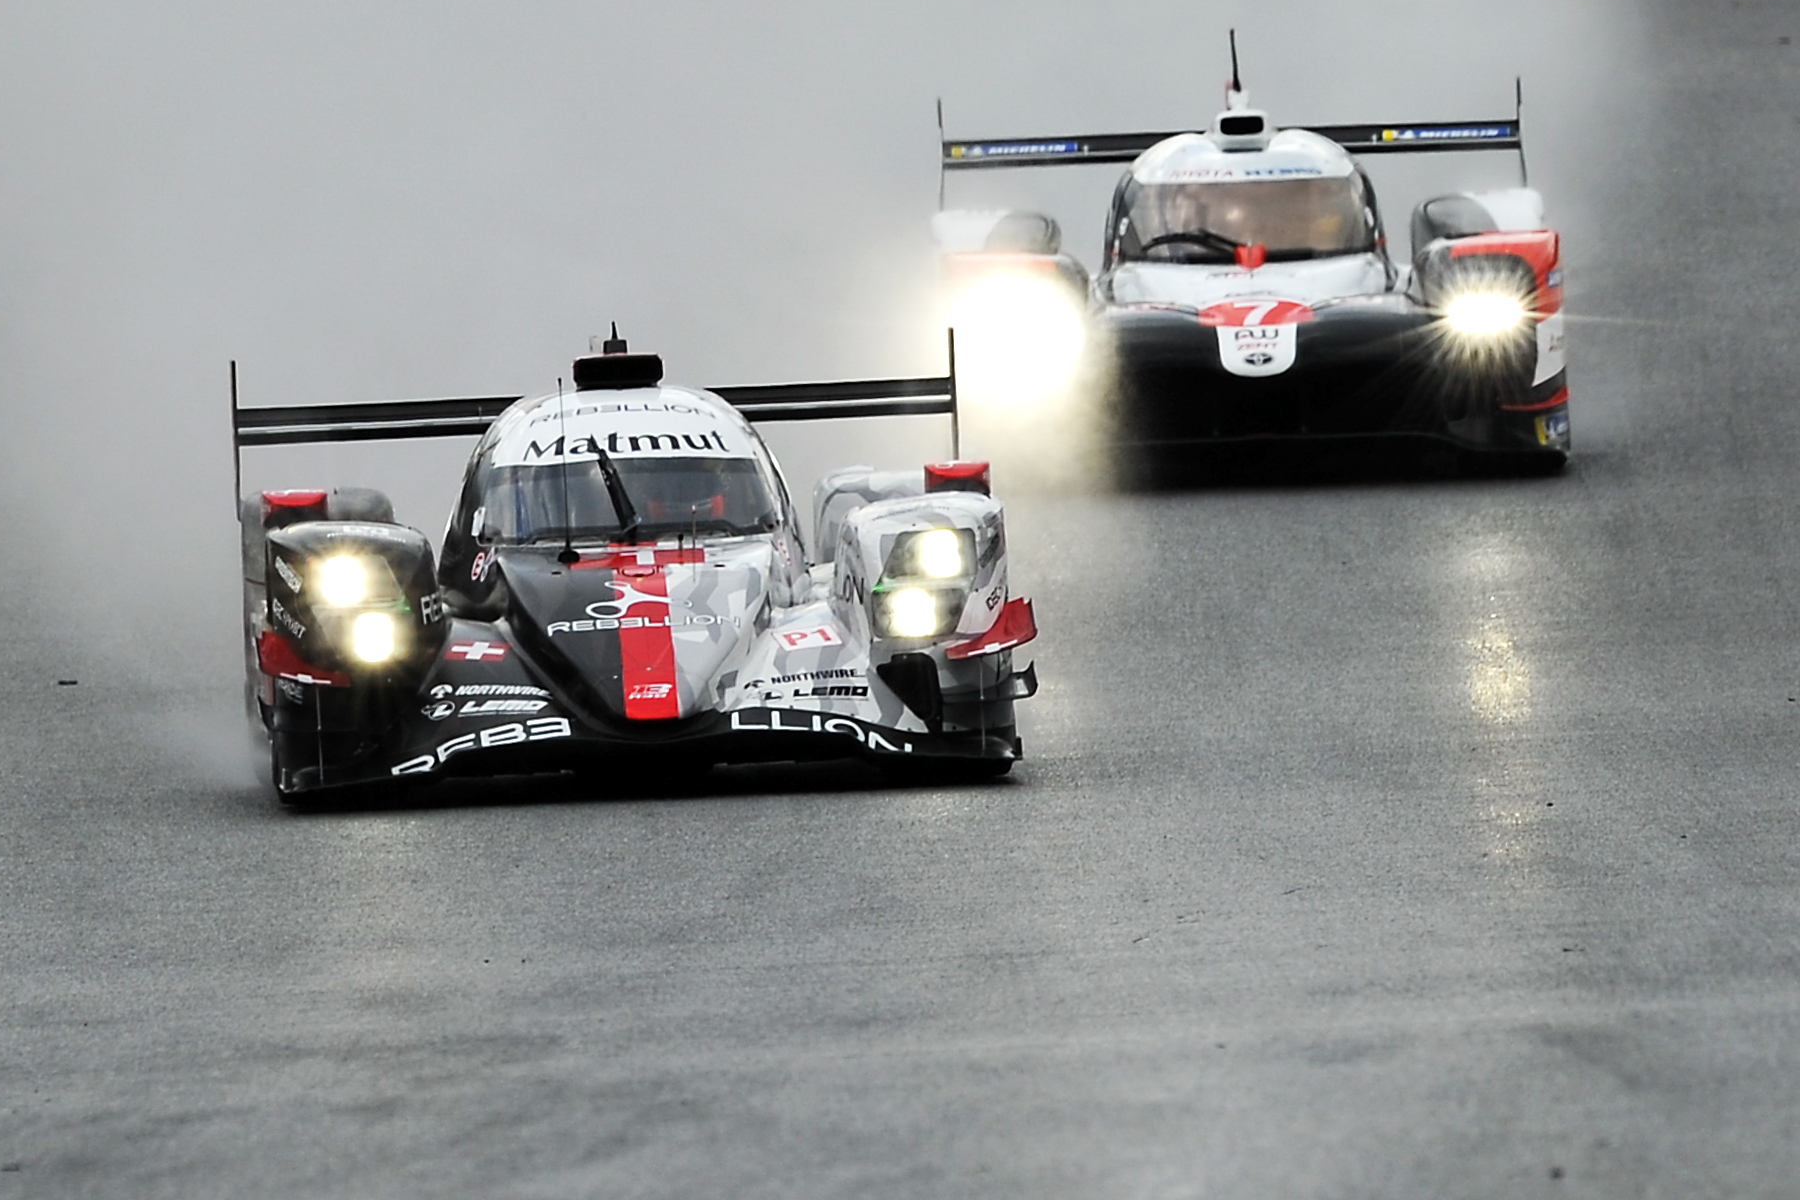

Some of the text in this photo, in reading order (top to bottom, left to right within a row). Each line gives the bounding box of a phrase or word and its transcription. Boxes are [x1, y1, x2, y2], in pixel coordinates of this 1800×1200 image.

[1233, 300, 1279, 327] 7
[523, 430, 731, 462] Matmut
[783, 628, 833, 647] P1
[770, 668, 860, 685] NORTHWIRE
[454, 684, 552, 699] NORTHWIRE
[792, 685, 869, 698] LEMO
[458, 700, 549, 714] LEMO
